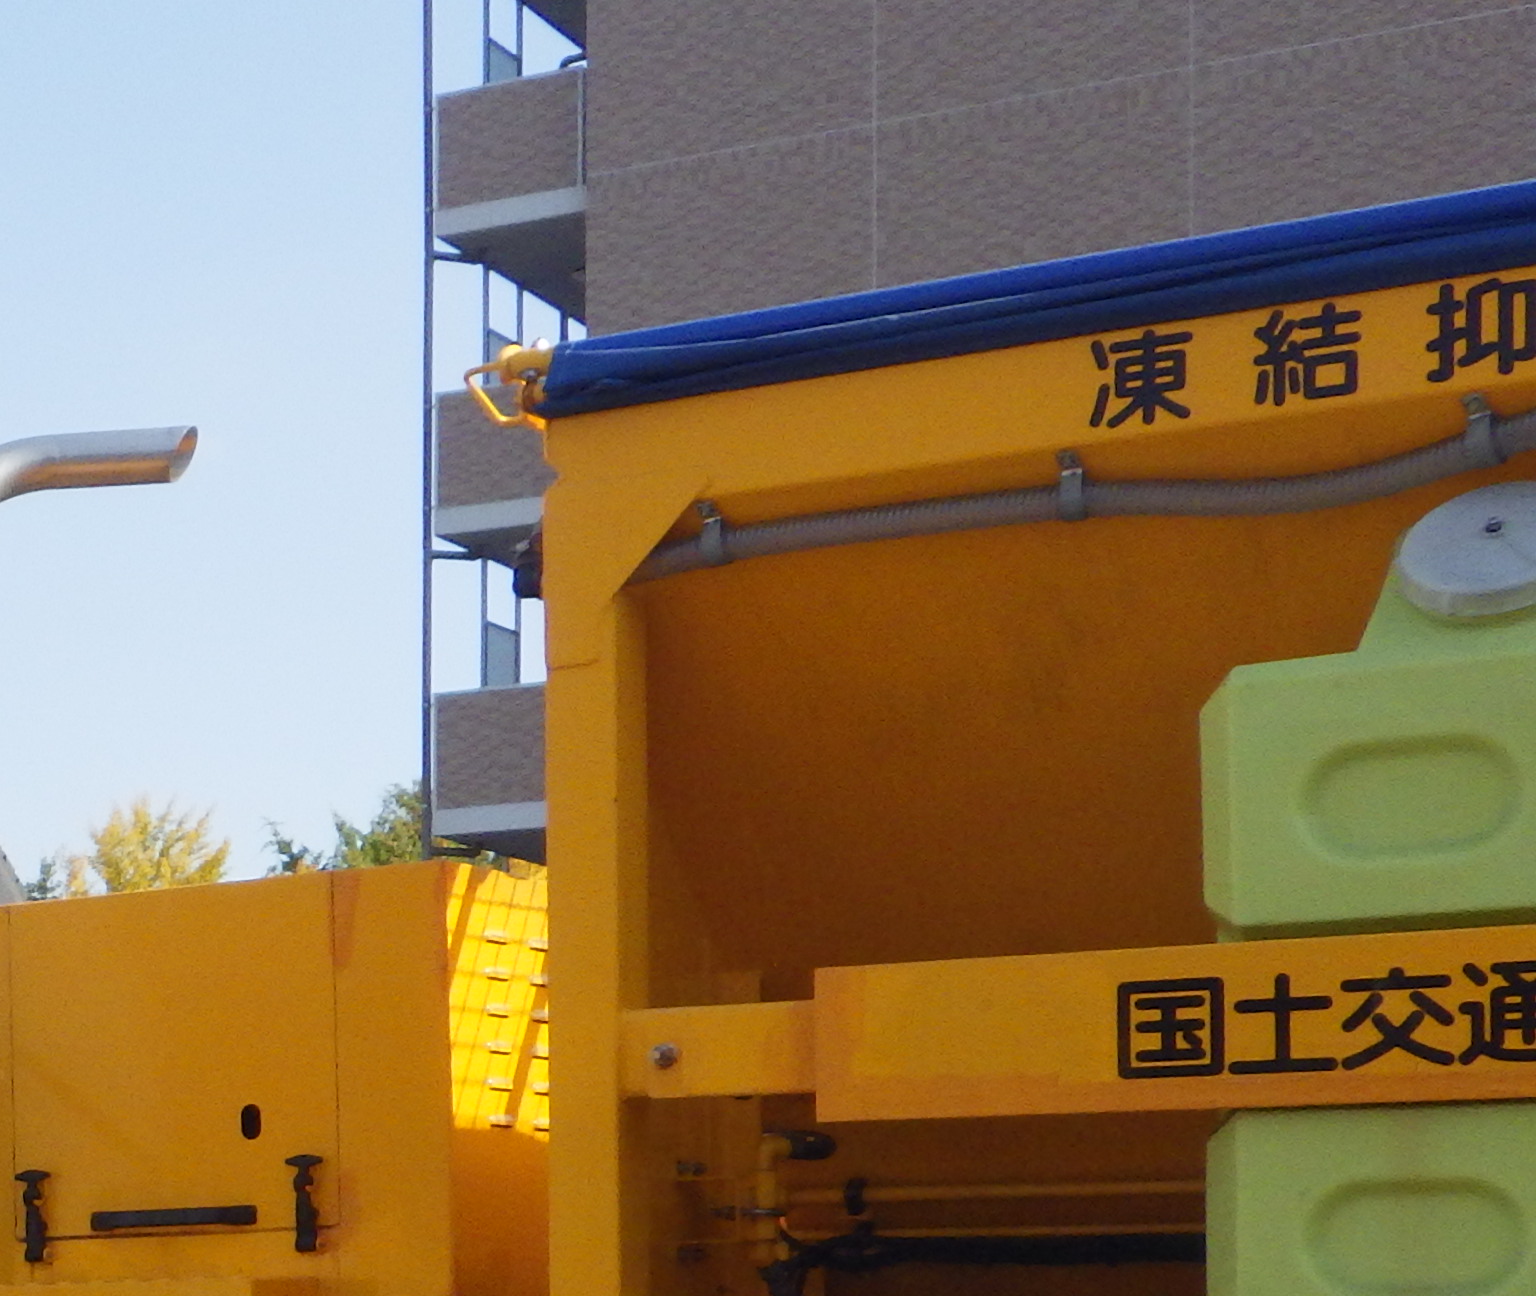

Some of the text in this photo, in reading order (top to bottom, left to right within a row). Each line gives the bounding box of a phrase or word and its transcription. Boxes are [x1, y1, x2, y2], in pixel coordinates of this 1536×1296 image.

[1090, 278, 1536, 428] 凍結抑
[1117, 962, 1536, 1080] 国土交通
